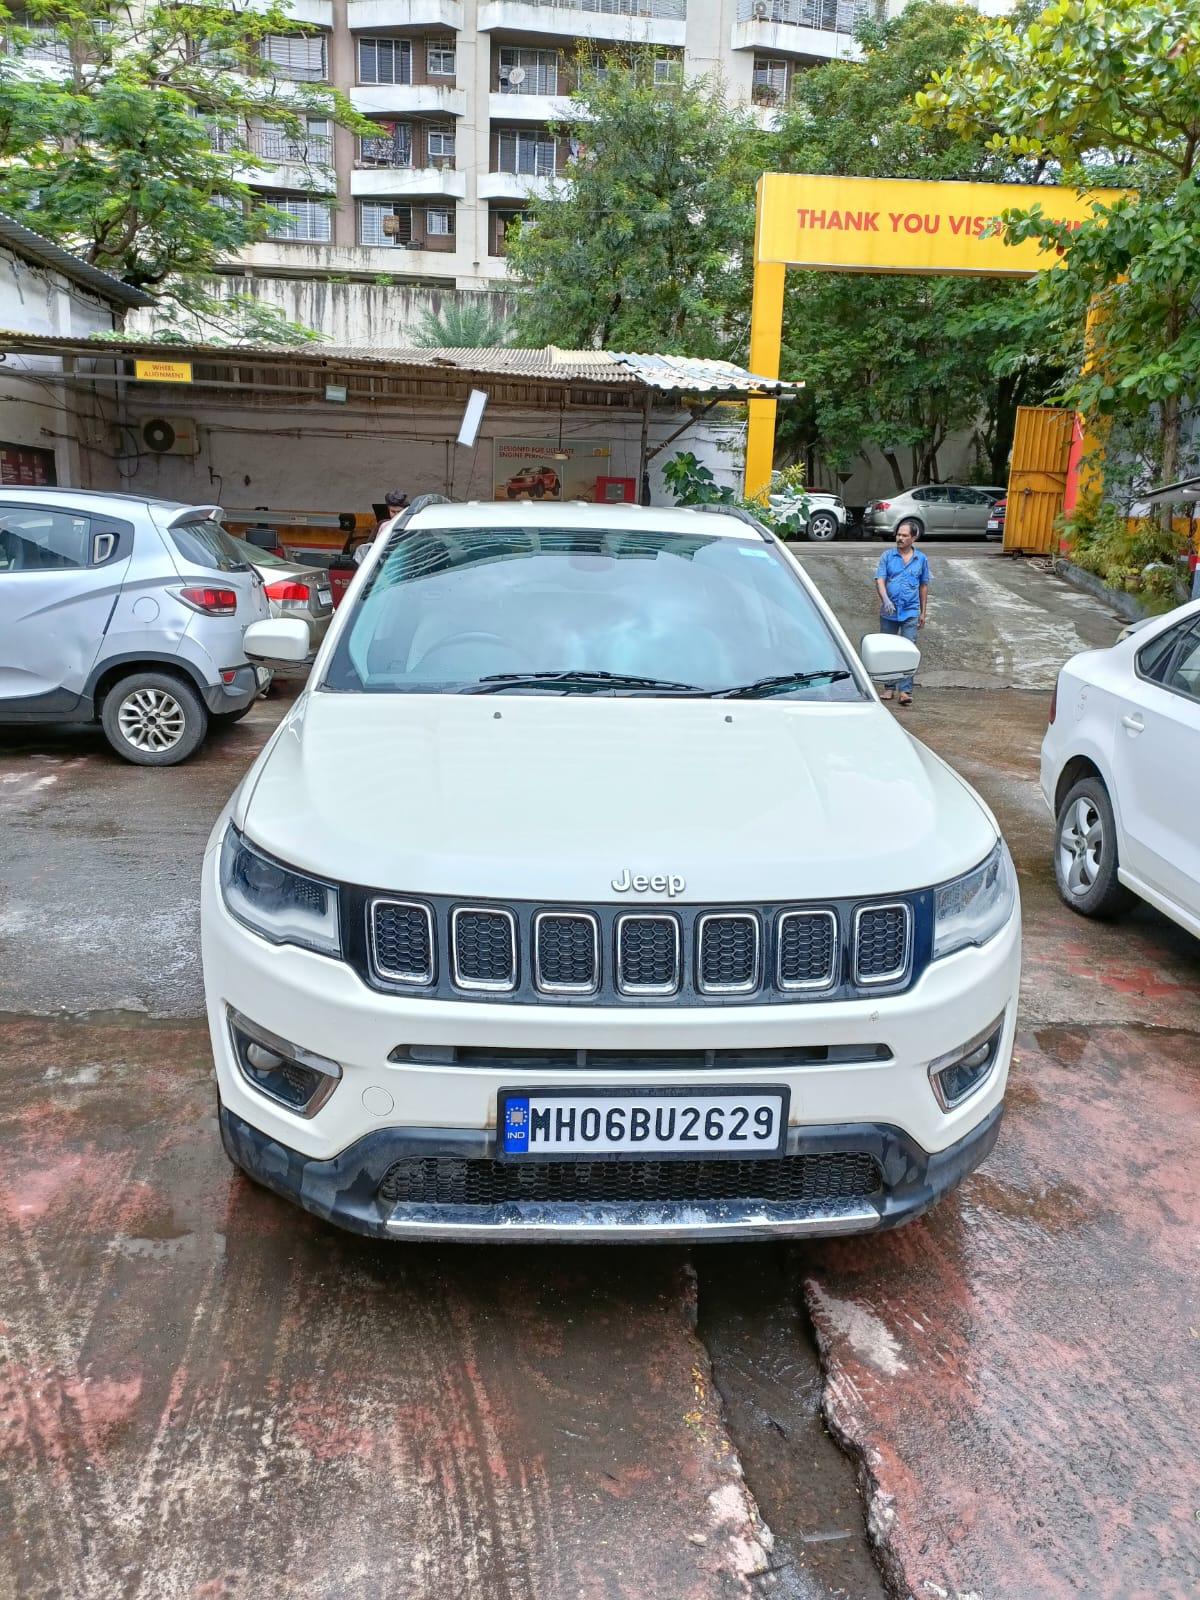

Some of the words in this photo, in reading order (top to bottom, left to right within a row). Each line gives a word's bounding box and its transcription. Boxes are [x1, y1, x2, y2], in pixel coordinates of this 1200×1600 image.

[797, 208, 880, 232] THANK
[888, 212, 940, 234] YOU
[143, 371, 185, 379] ALIGNMENT
[151, 364, 175, 372] WHEEL
[610, 868, 686, 898] Jeep
[530, 1106, 774, 1142] MH06BU2629
[507, 1131, 526, 1140] IND
